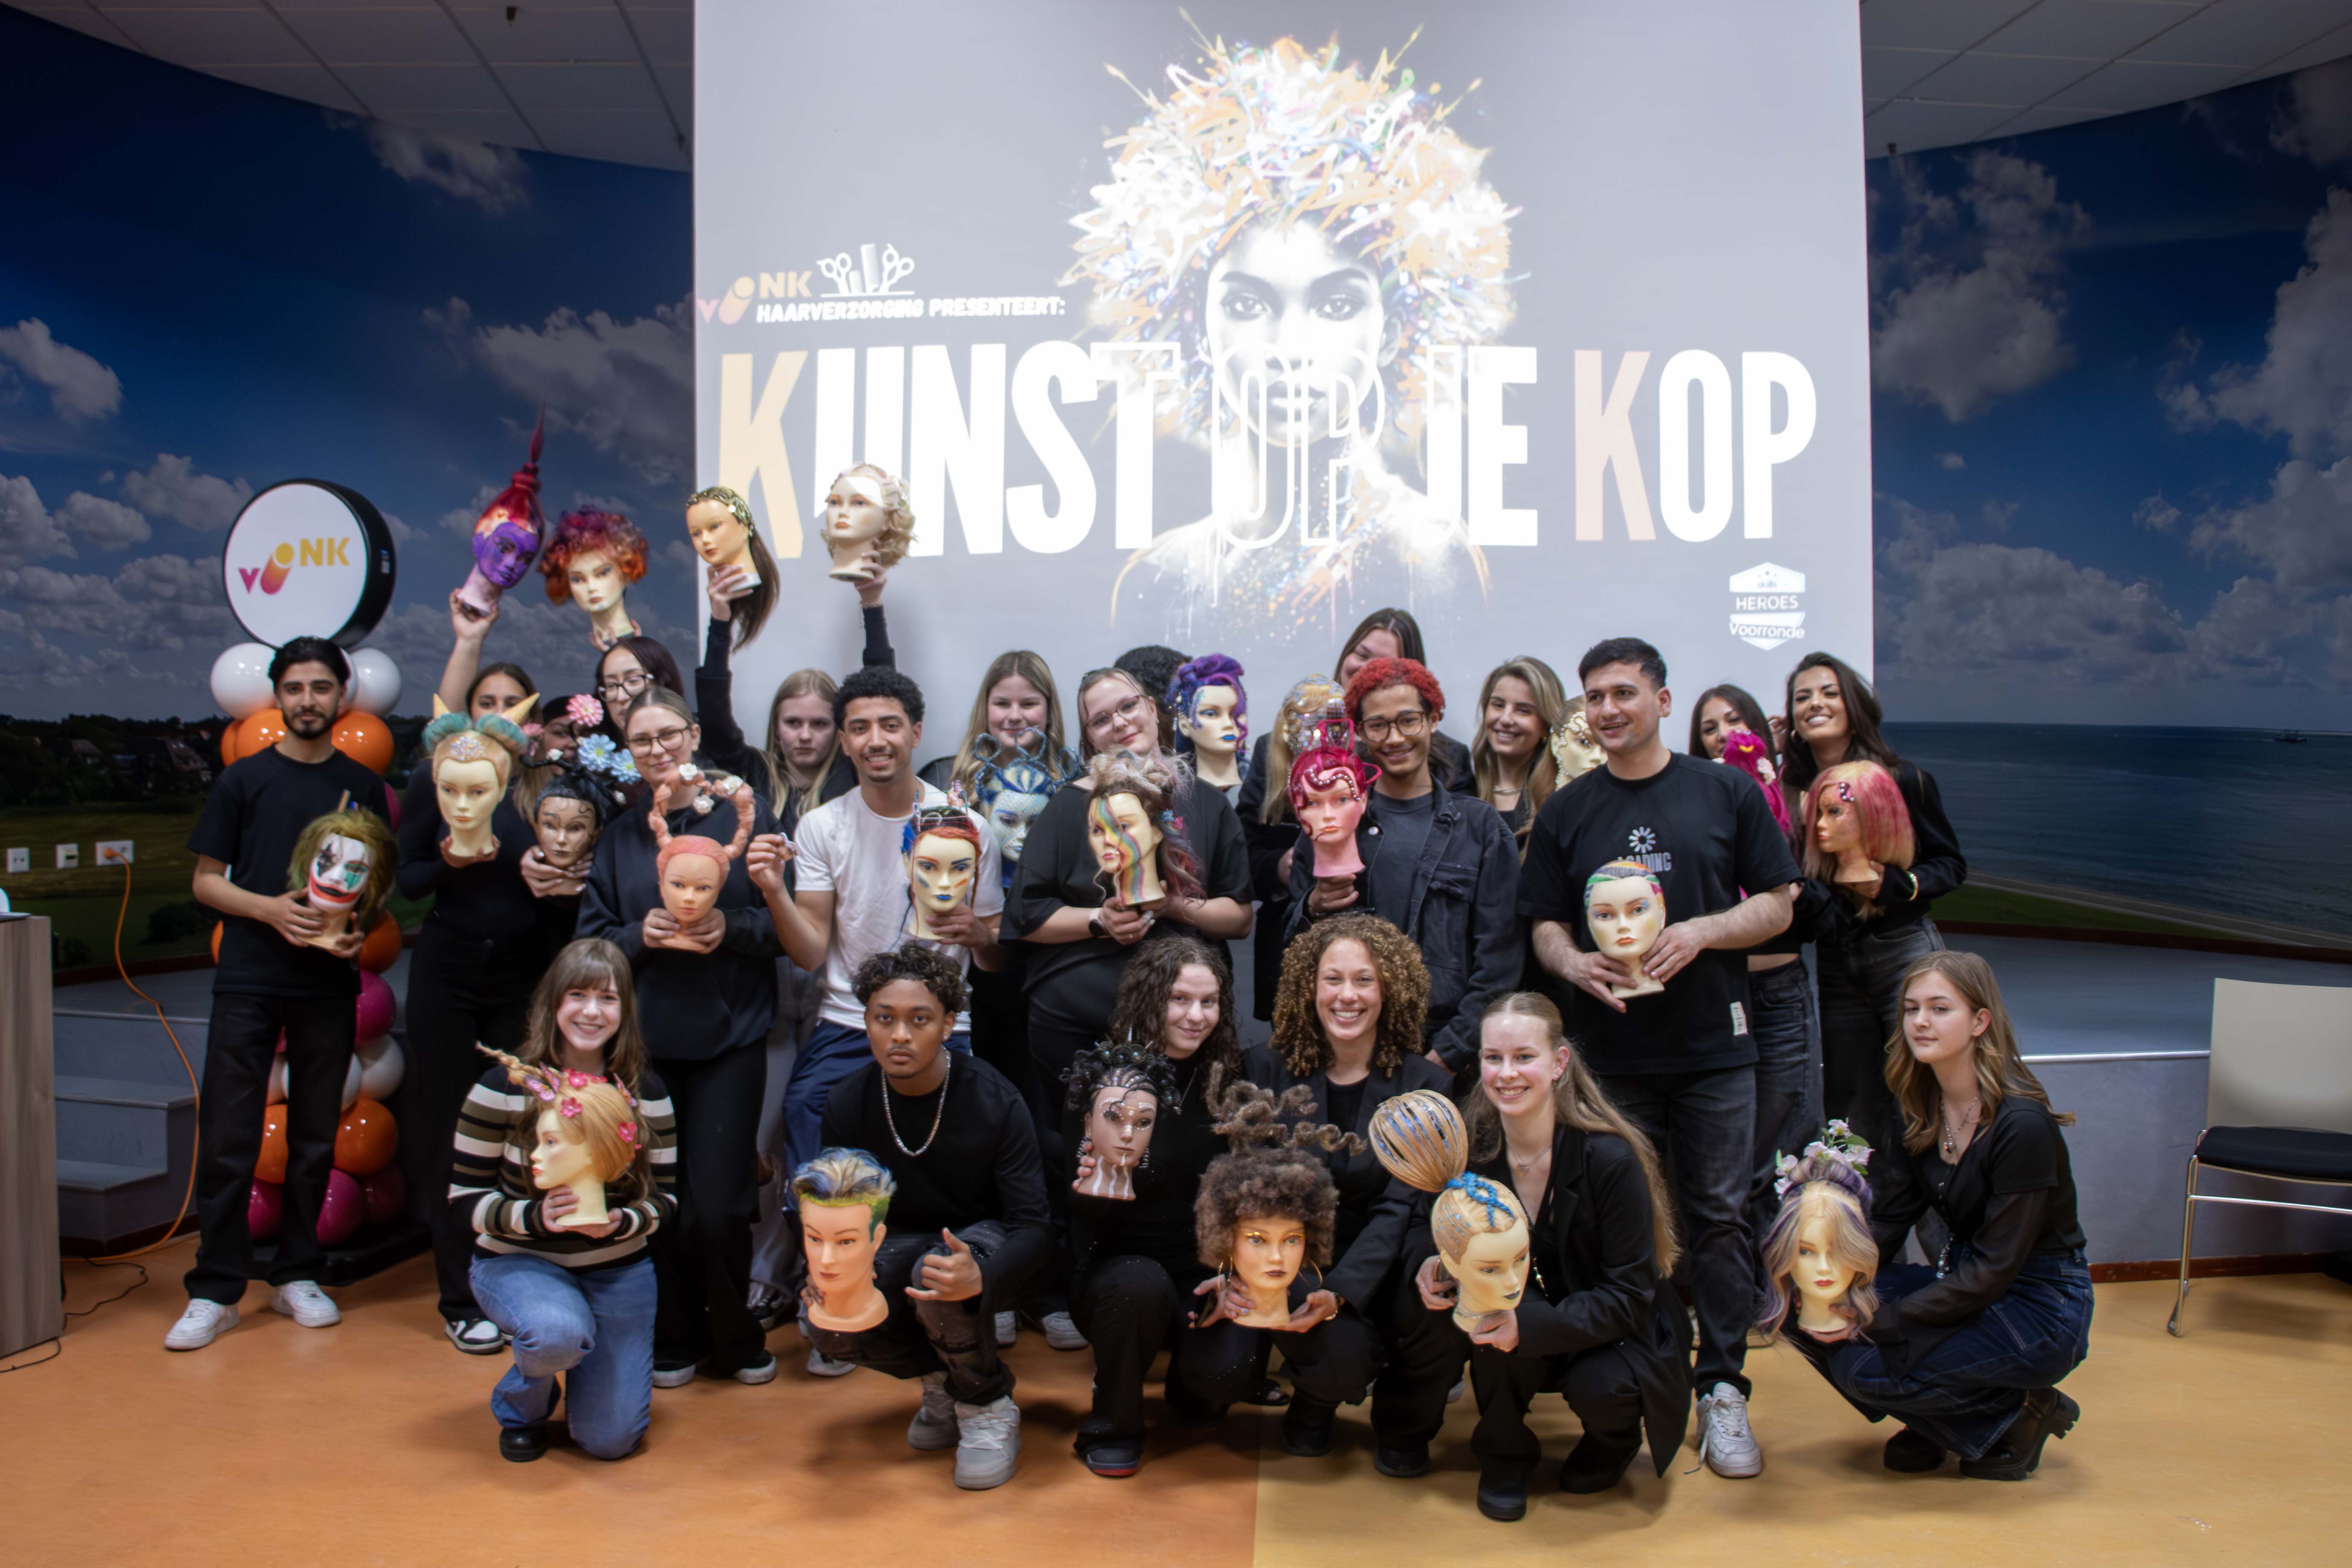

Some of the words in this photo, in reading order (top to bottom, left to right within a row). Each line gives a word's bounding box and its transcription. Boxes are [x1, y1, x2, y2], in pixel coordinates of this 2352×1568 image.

[756, 298, 924, 323] HAARVERZORGING
[929, 296, 1065, 317] PRESENTEERT:
[718, 340, 1180, 559] KUNST
[1211, 342, 1386, 548] OP
[1574, 349, 1816, 542] KOP
[1736, 595, 1798, 610] HEROES
[1729, 622, 1805, 639] Voorronde
[1617, 852, 1672, 872] DING
